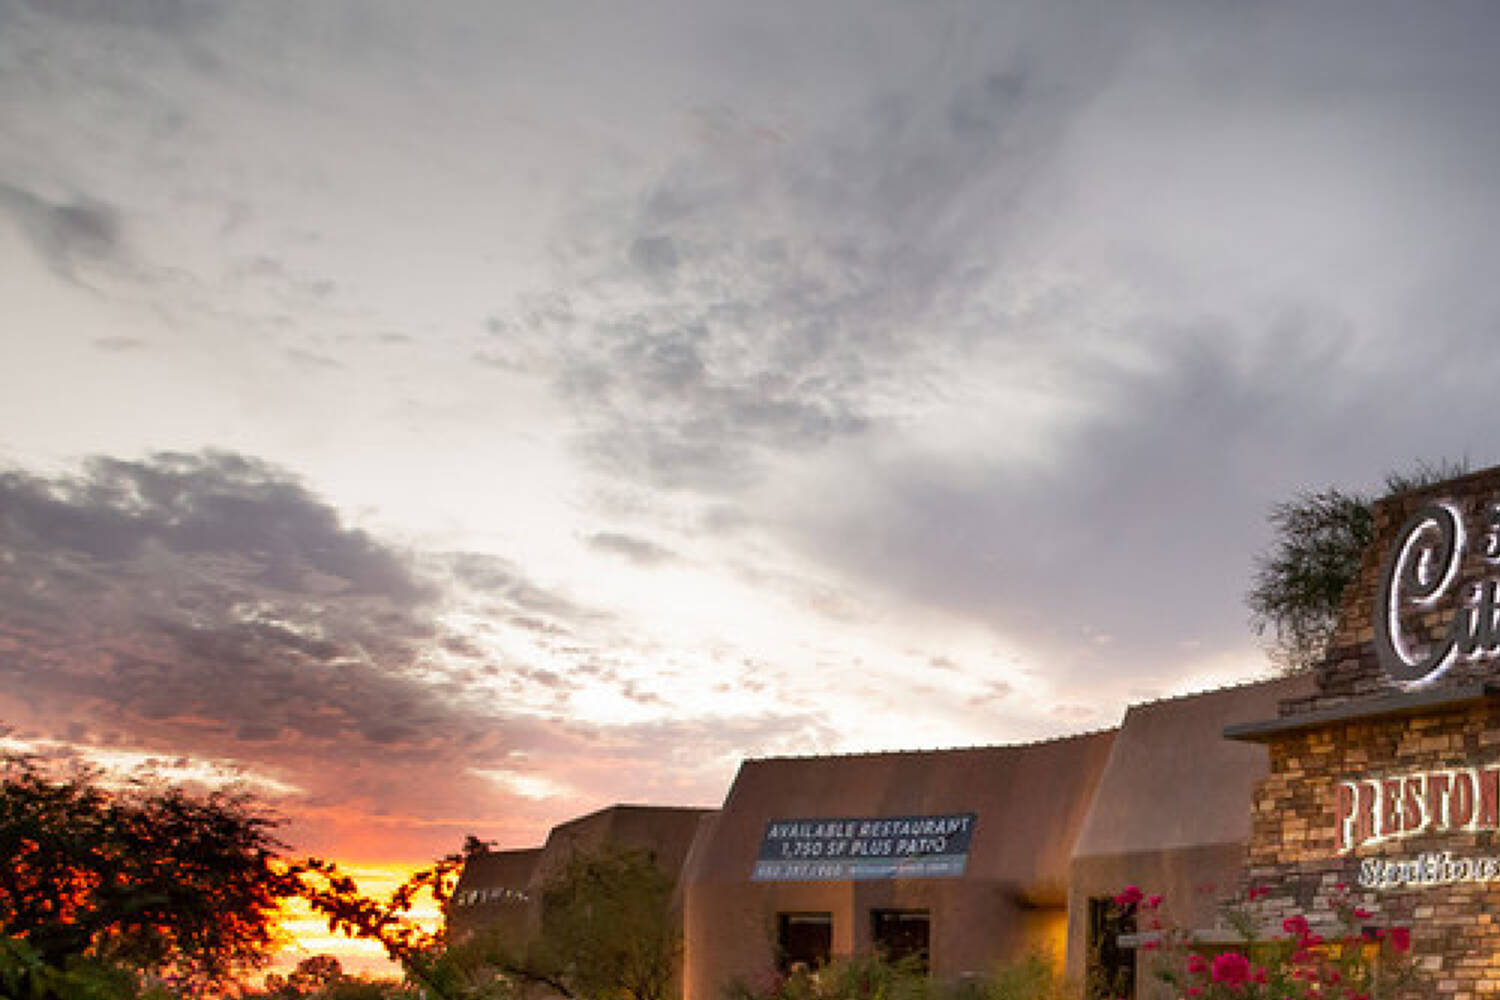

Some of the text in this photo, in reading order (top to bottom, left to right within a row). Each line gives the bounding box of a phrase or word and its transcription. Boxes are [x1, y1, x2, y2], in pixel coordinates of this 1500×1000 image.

[768, 818, 969, 839] AVAILABLE RESTAURANT
[828, 840, 847, 856] SF
[850, 839, 892, 855] PLUS
[895, 837, 946, 854] PATIO
